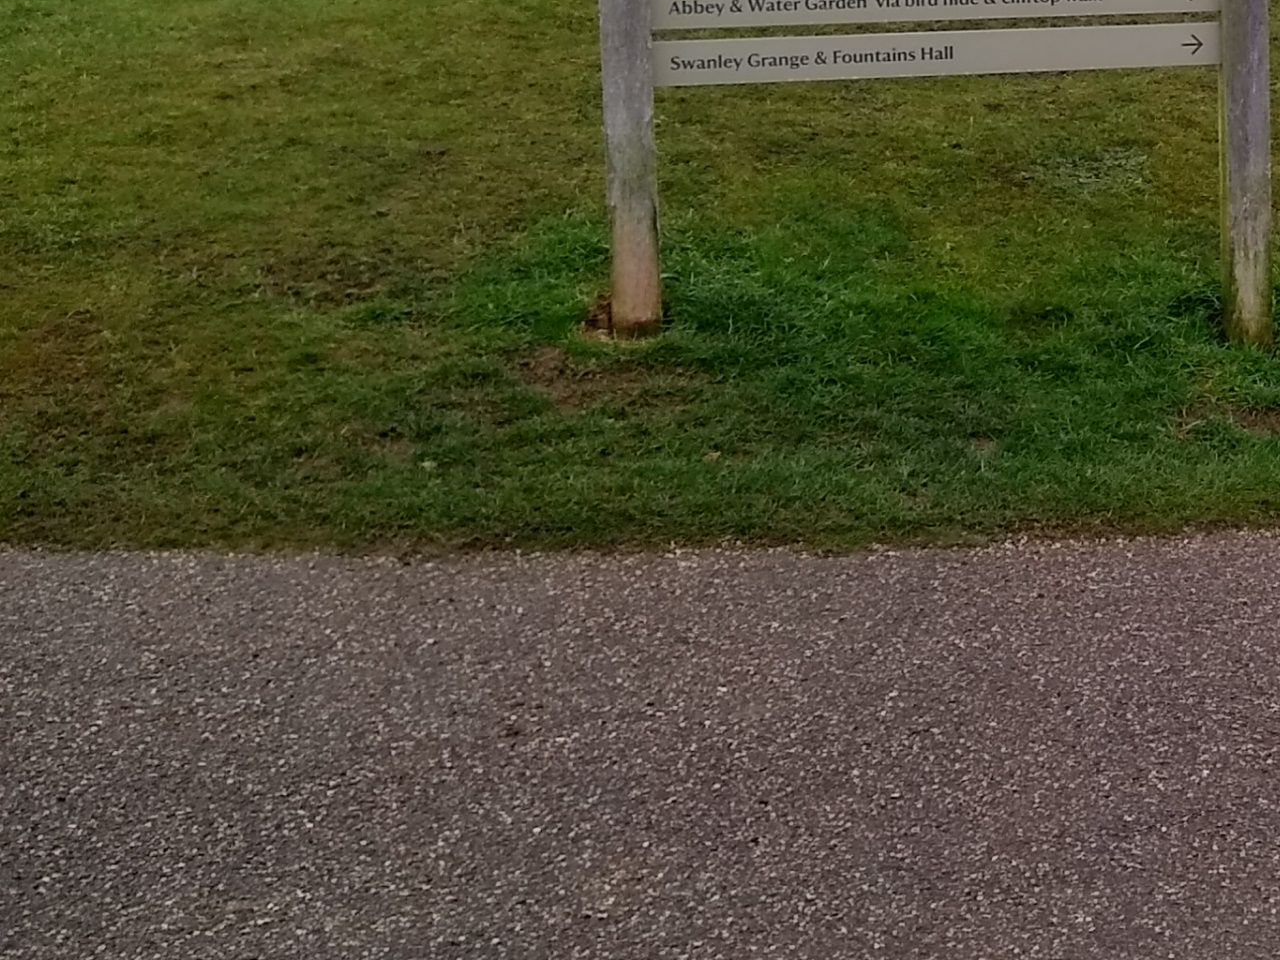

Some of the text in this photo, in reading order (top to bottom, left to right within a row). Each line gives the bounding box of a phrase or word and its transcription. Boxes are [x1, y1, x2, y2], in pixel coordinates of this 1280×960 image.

[668, 0, 725, 17] Abbey
[729, 0, 743, 13] &
[670, 46, 954, 71] Swanley Grange & Fountains Hall
